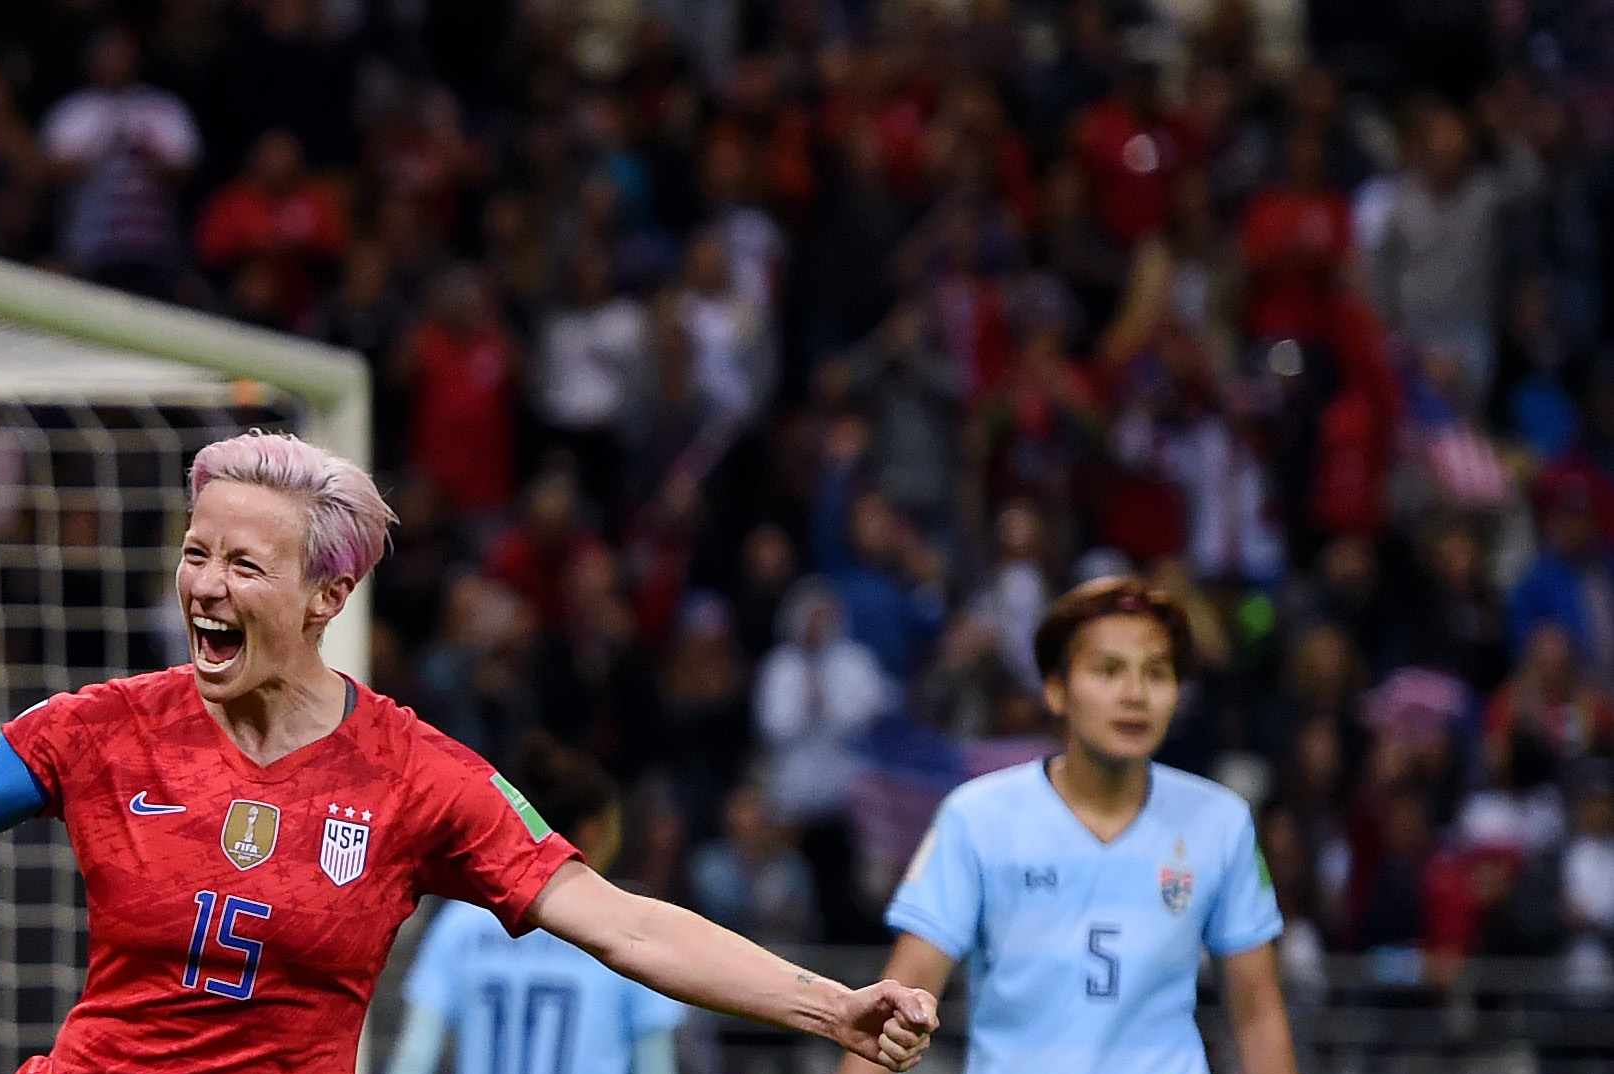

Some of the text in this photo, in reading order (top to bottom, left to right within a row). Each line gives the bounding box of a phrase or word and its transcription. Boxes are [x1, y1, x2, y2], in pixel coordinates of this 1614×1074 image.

[234, 841, 258, 854] FIFA
[327, 823, 365, 850] USA
[182, 890, 272, 1000] 15
[1086, 922, 1121, 1000] 5
